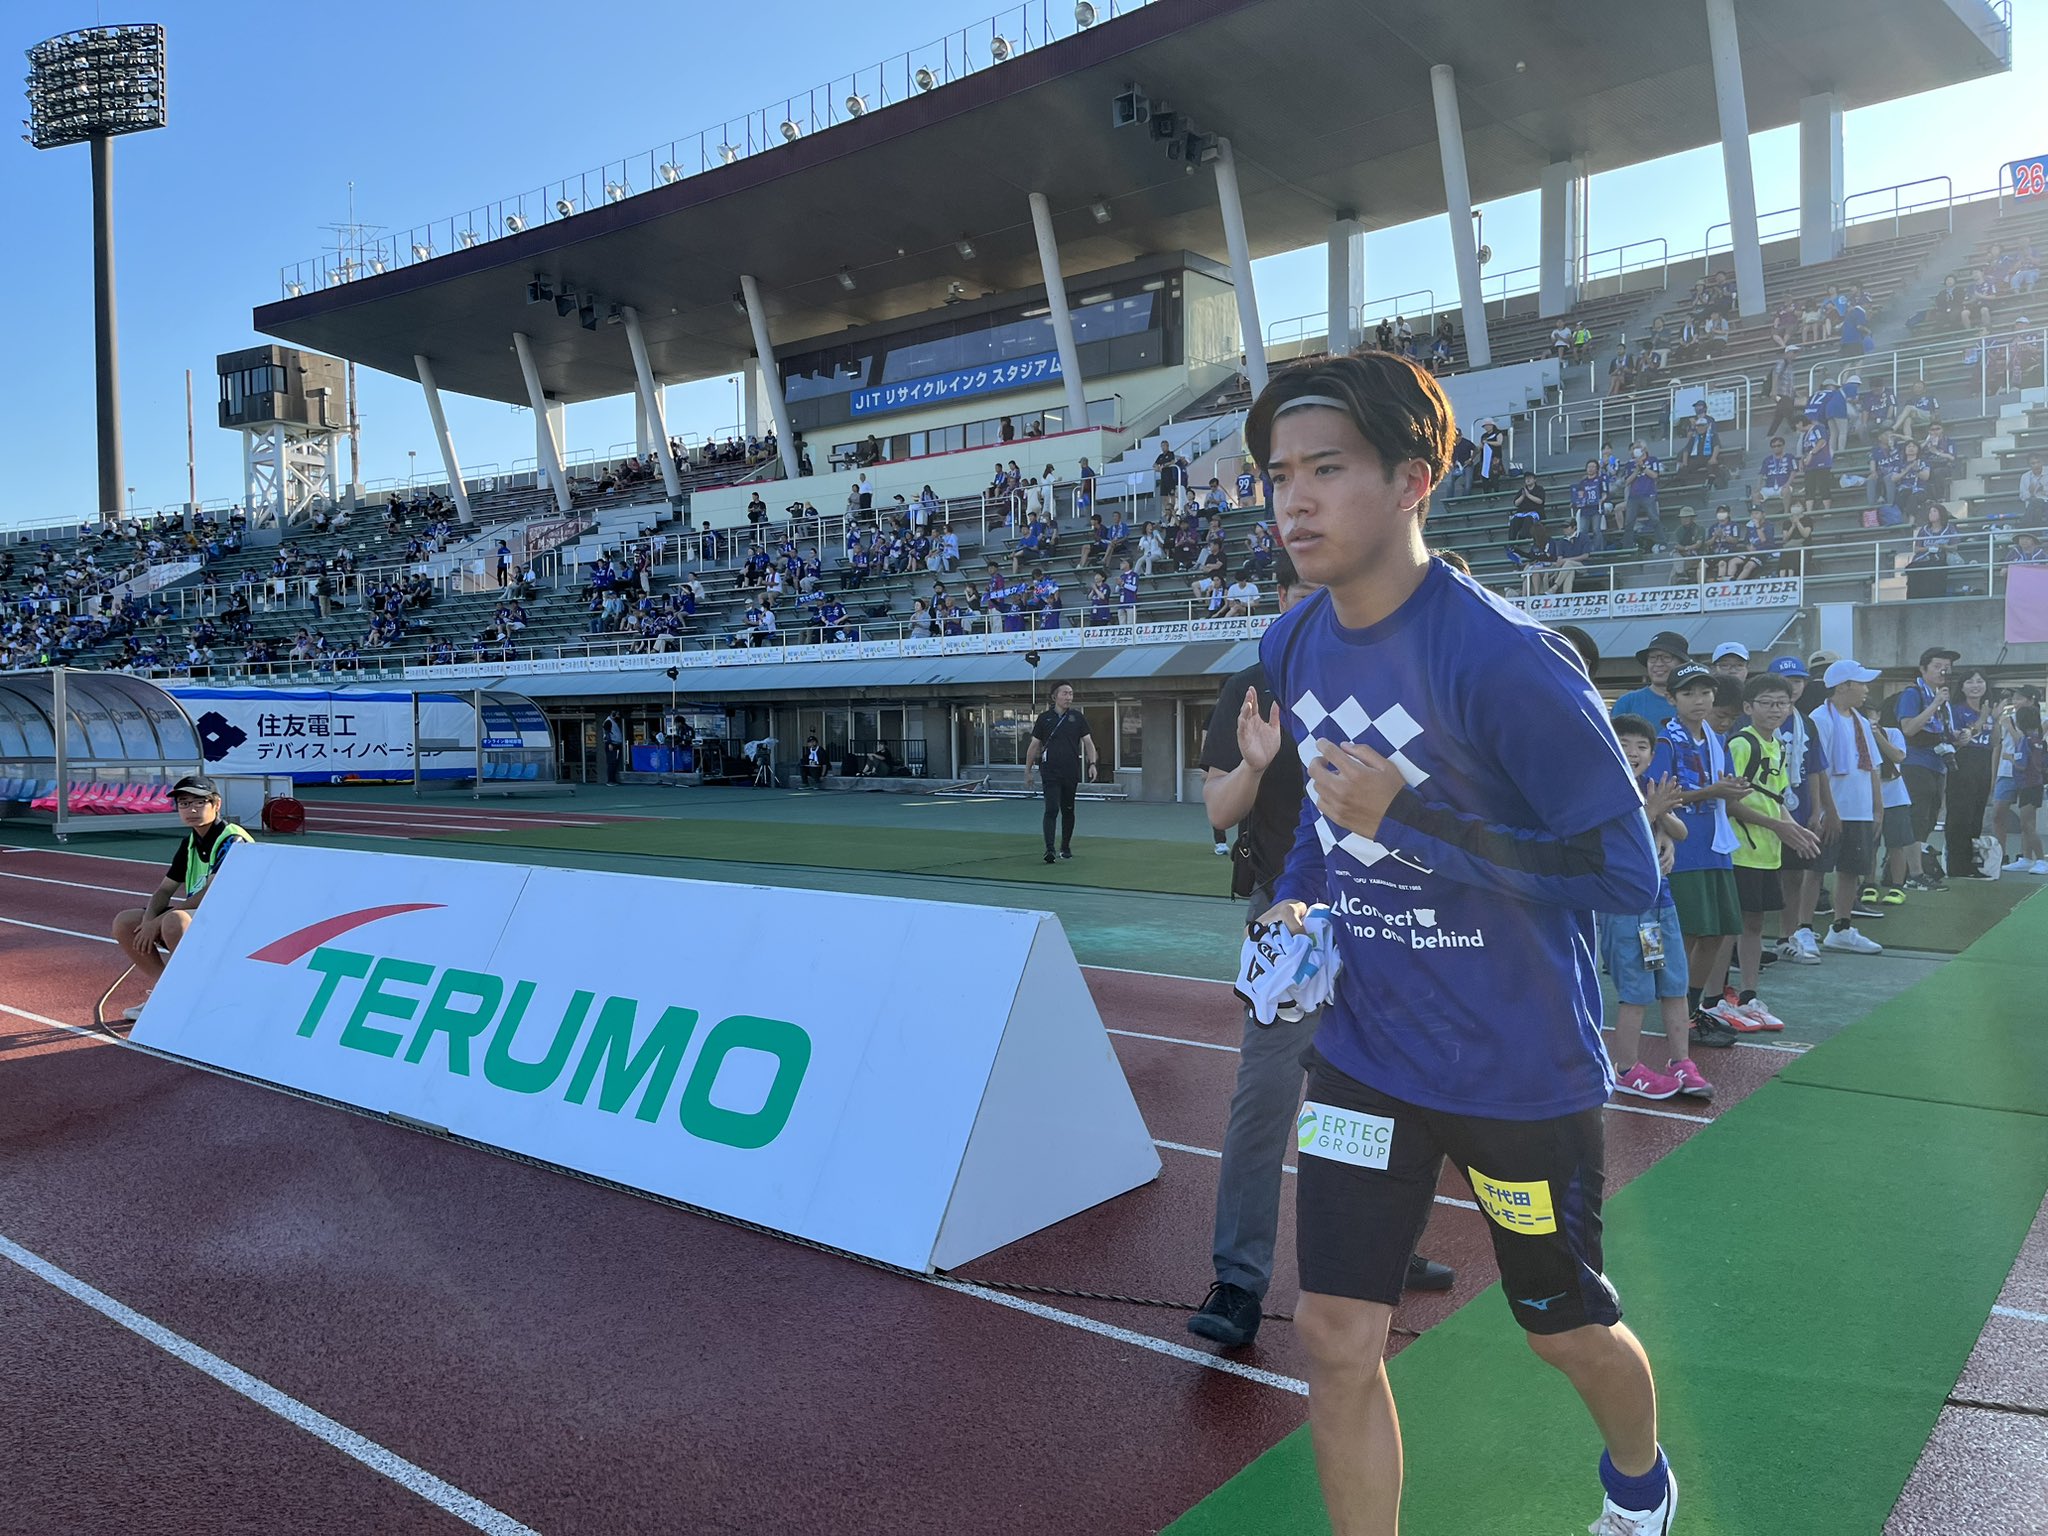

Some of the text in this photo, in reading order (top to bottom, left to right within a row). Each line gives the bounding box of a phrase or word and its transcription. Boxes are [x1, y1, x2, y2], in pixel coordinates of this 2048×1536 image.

[2015, 162, 2045, 198] 26
[855, 357, 1063, 410] JIT リサイクルインク スタジアム
[1809, 392, 1827, 405] 12
[1238, 478, 1250, 490] 99
[1587, 490, 1597, 500] 18
[1614, 588, 1699, 604] GLITTER
[1705, 581, 1798, 598] GLITTER
[1530, 594, 1608, 610] GLITTER
[1660, 602, 1698, 611] グリッター
[1755, 594, 1797, 605] グリッター
[1572, 606, 1608, 617] グリッター
[1083, 627, 1133, 639] GLITTER
[1135, 623, 1188, 635] GLITTER
[1191, 619, 1247, 632] GLITTER
[1677, 665, 1710, 677] adidas
[257, 713, 357, 737] 住友電工
[1348, 897, 1413, 926] Conect
[1354, 924, 1376, 939] no
[1381, 928, 1405, 944] on
[1411, 928, 1485, 949] behind
[296, 946, 812, 1150] TERUMO
[1321, 1114, 1390, 1144] ERTEC
[1318, 1135, 1387, 1160] GROUP
[1482, 1182, 1531, 1206] 千代田
